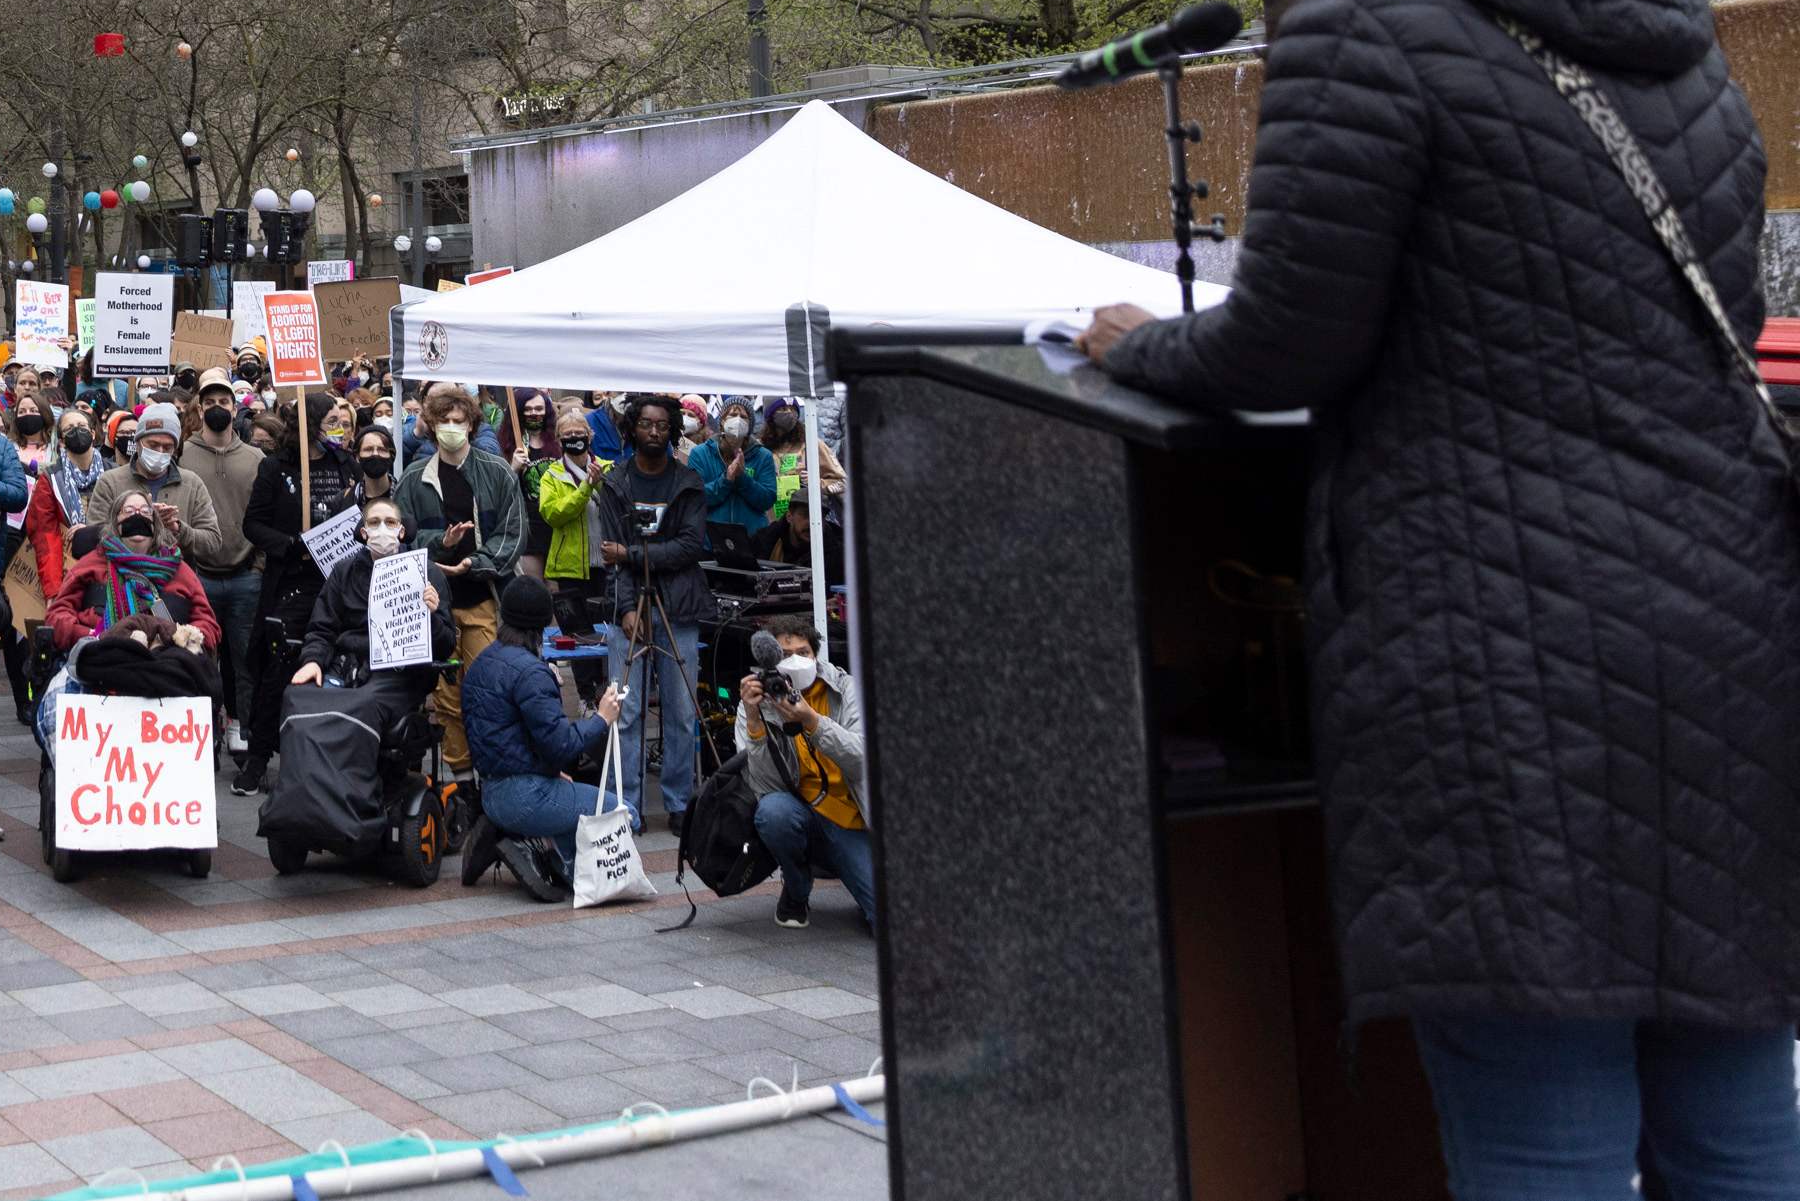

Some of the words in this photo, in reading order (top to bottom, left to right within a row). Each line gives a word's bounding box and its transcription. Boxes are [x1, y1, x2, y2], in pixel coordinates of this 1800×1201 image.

[120, 286, 151, 296] Forced
[107, 300, 162, 311] Motherhood
[269, 306, 290, 316] STAND
[291, 305, 300, 313] UP
[301, 304, 312, 313] FOR
[130, 315, 138, 325] is
[271, 313, 314, 328] ABORTION
[117, 330, 150, 341] Female
[273, 329, 282, 340] &
[284, 326, 315, 341] LGBTQ
[104, 344, 162, 356] Enslavement
[276, 341, 317, 360] RIGHTS
[315, 536, 342, 556] BREAK
[320, 555, 336, 566] THE
[375, 564, 409, 584] CHRISTIAN
[374, 577, 400, 593] FASCIST
[384, 598, 398, 609] GET
[400, 591, 421, 606] YOUR
[392, 604, 414, 618] LAWS
[385, 611, 427, 630] VIGILANTES
[391, 626, 405, 639] OFF
[406, 622, 422, 637] OUR
[393, 634, 421, 649] BODIES!
[61, 707, 114, 758] My
[141, 709, 210, 761] Body
[103, 746, 164, 799] My
[70, 783, 202, 826] Choice
